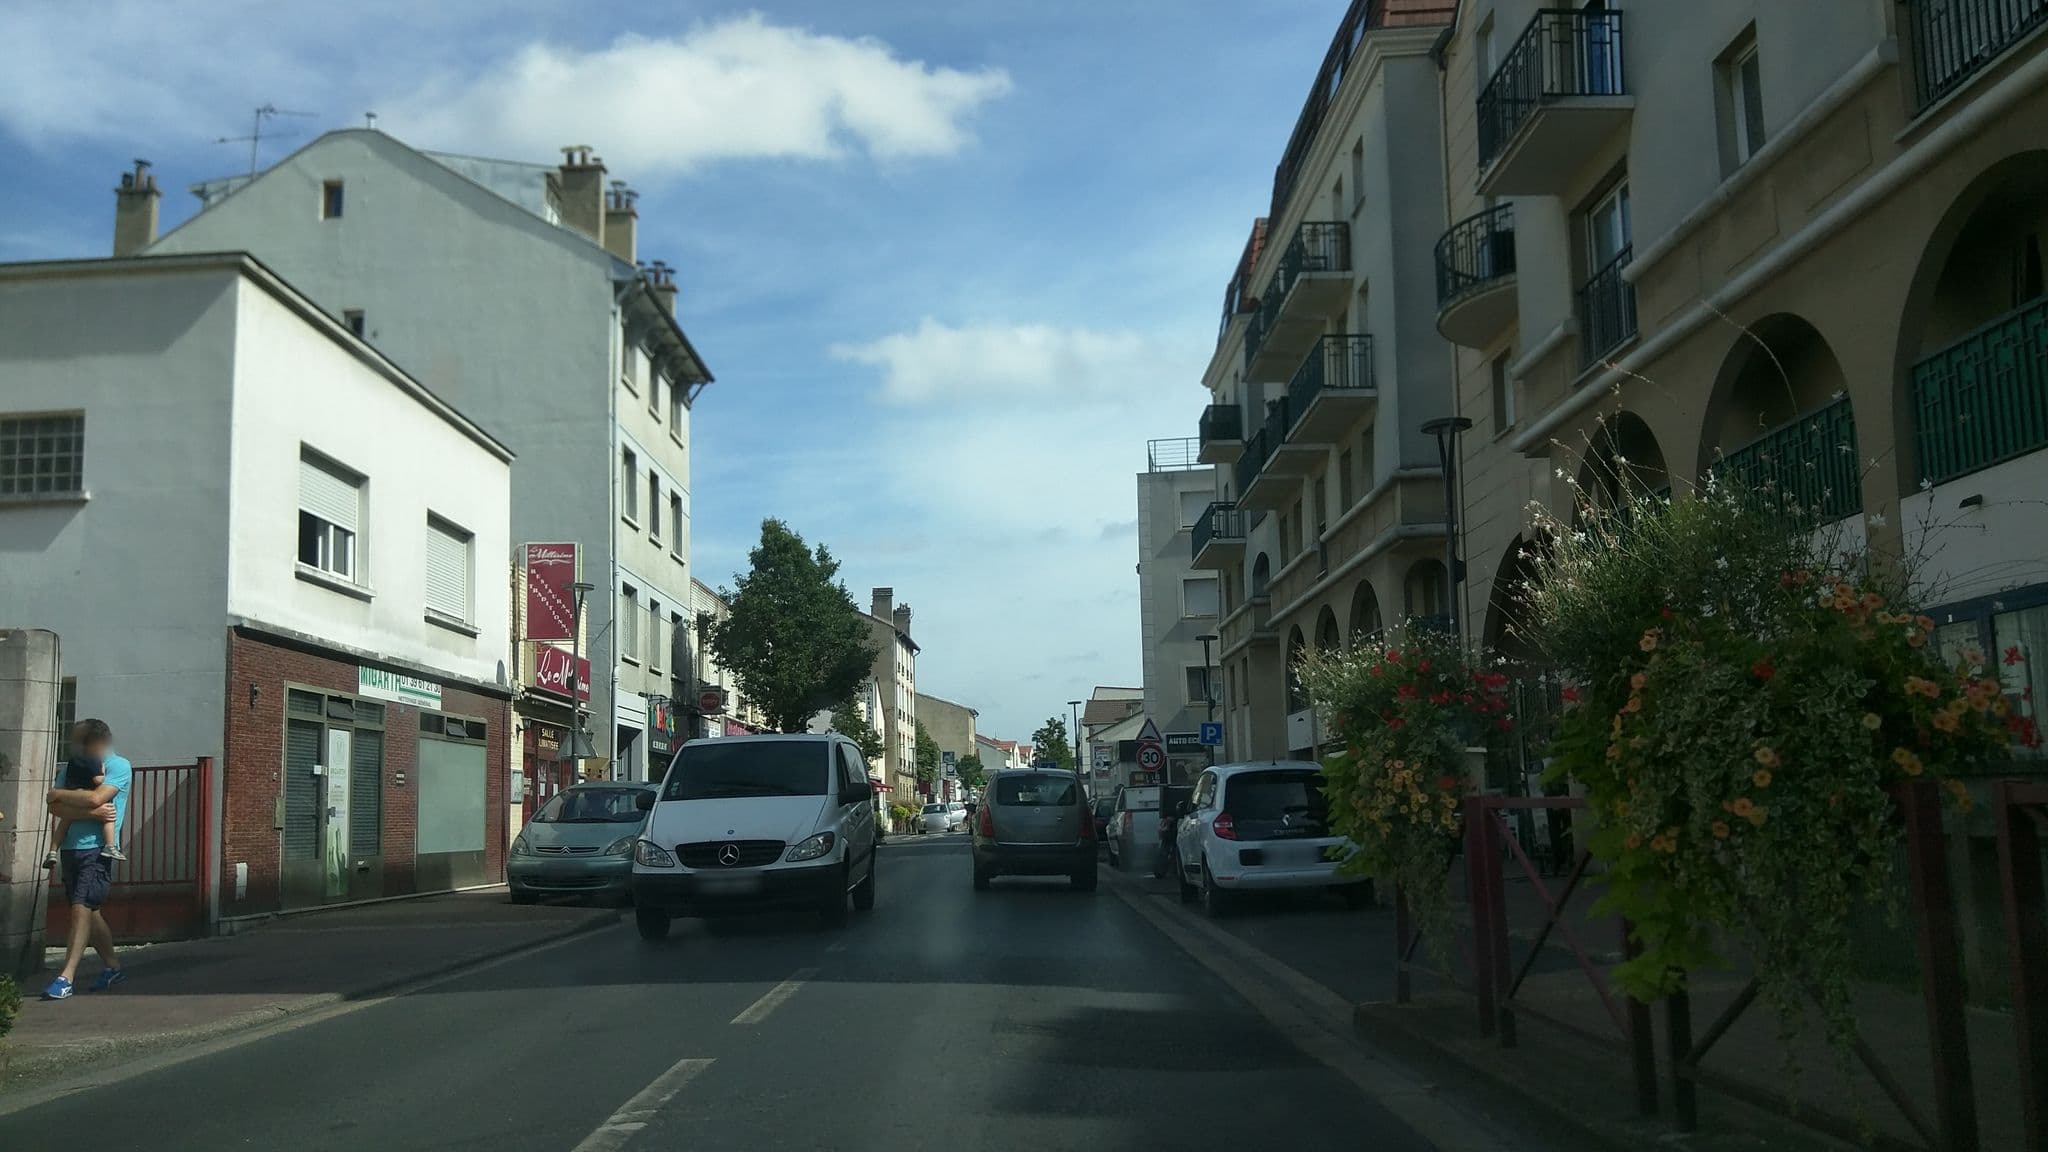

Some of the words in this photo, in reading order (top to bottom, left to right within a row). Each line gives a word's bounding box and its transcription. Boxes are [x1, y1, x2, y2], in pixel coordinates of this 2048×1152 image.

[531, 568, 574, 619] RESTAURANT
[530, 584, 573, 638] TRADITIONNEL
[1168, 737, 1187, 745] AUTO
[1206, 726, 1217, 741] P
[1142, 752, 1159, 764] 30
